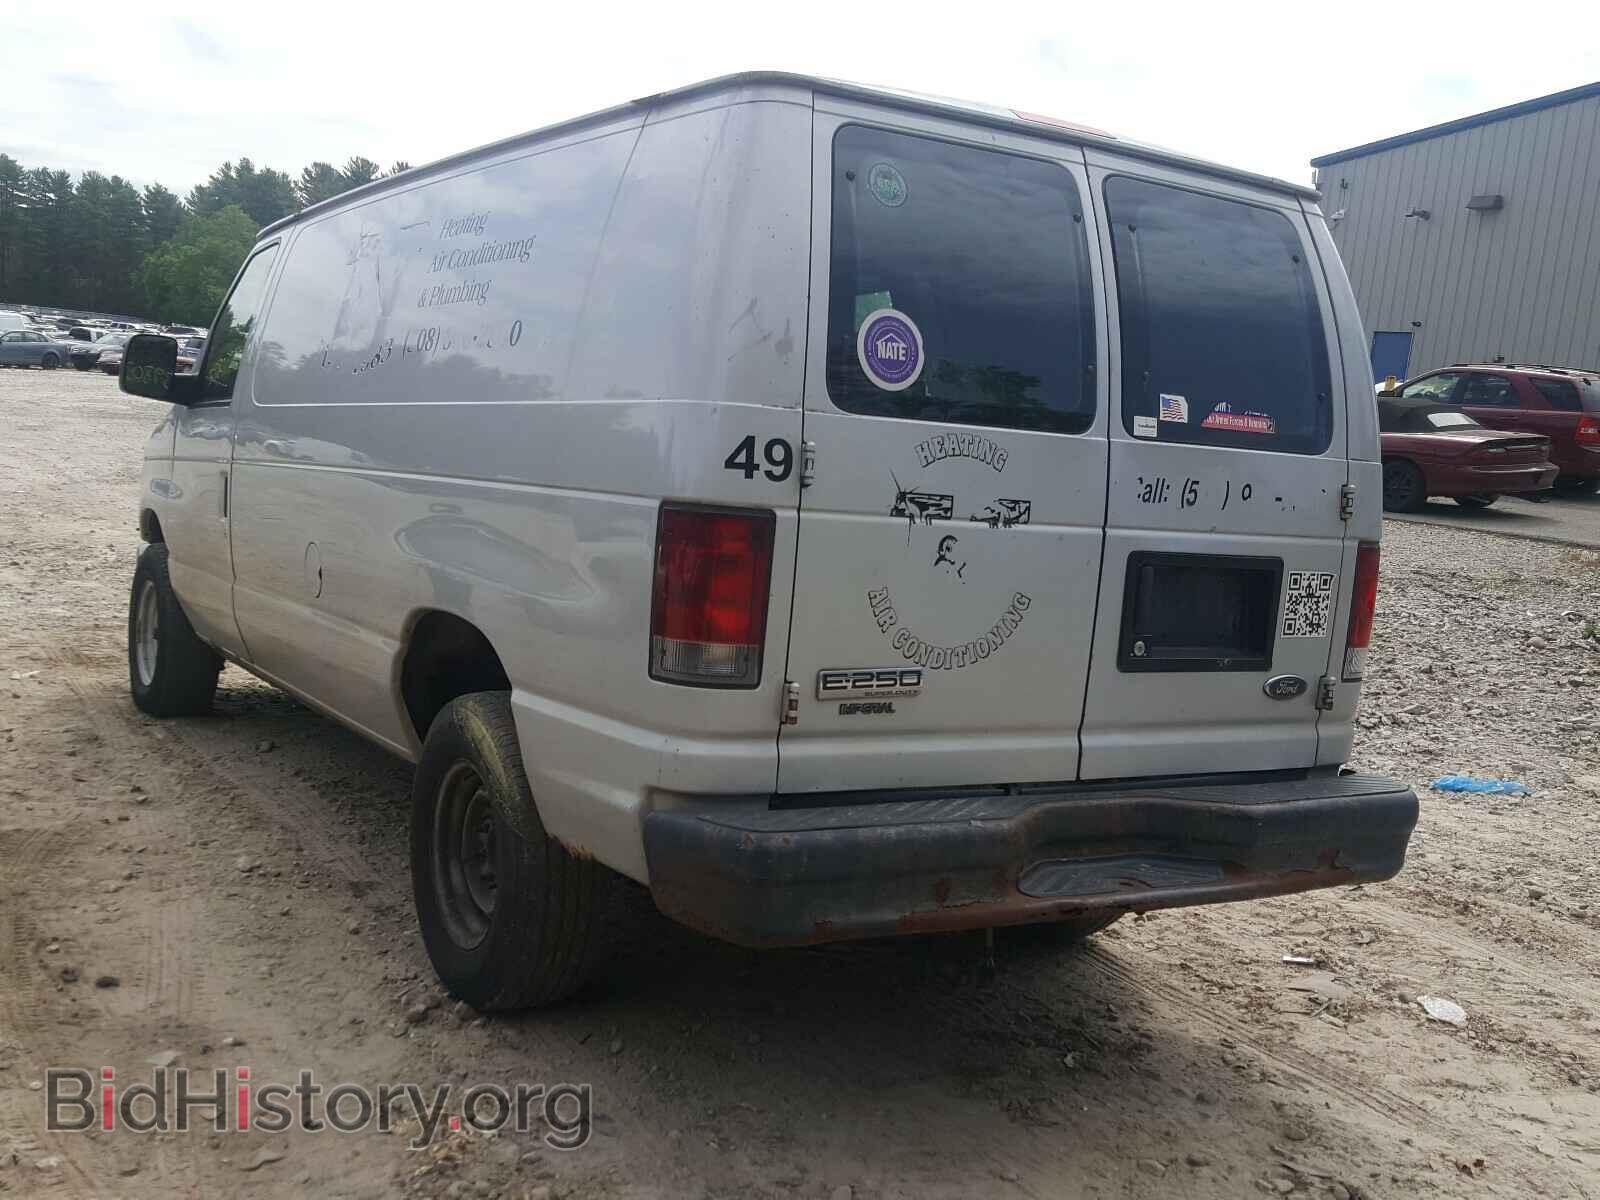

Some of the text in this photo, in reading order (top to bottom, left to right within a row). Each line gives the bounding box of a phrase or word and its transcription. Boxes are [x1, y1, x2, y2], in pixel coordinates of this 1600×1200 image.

[440, 210, 492, 239] Heating
[427, 235, 536, 273] Air Conditioning
[429, 279, 492, 307] Plumbing
[402, 325, 441, 361] (08)
[876, 341, 907, 361] NATE
[724, 434, 793, 483] 49
[915, 433, 1009, 472] HEATING
[1137, 477, 1171, 504] all:
[868, 586, 1032, 670] AIR CONDITIONING
[822, 671, 922, 690] E-250
